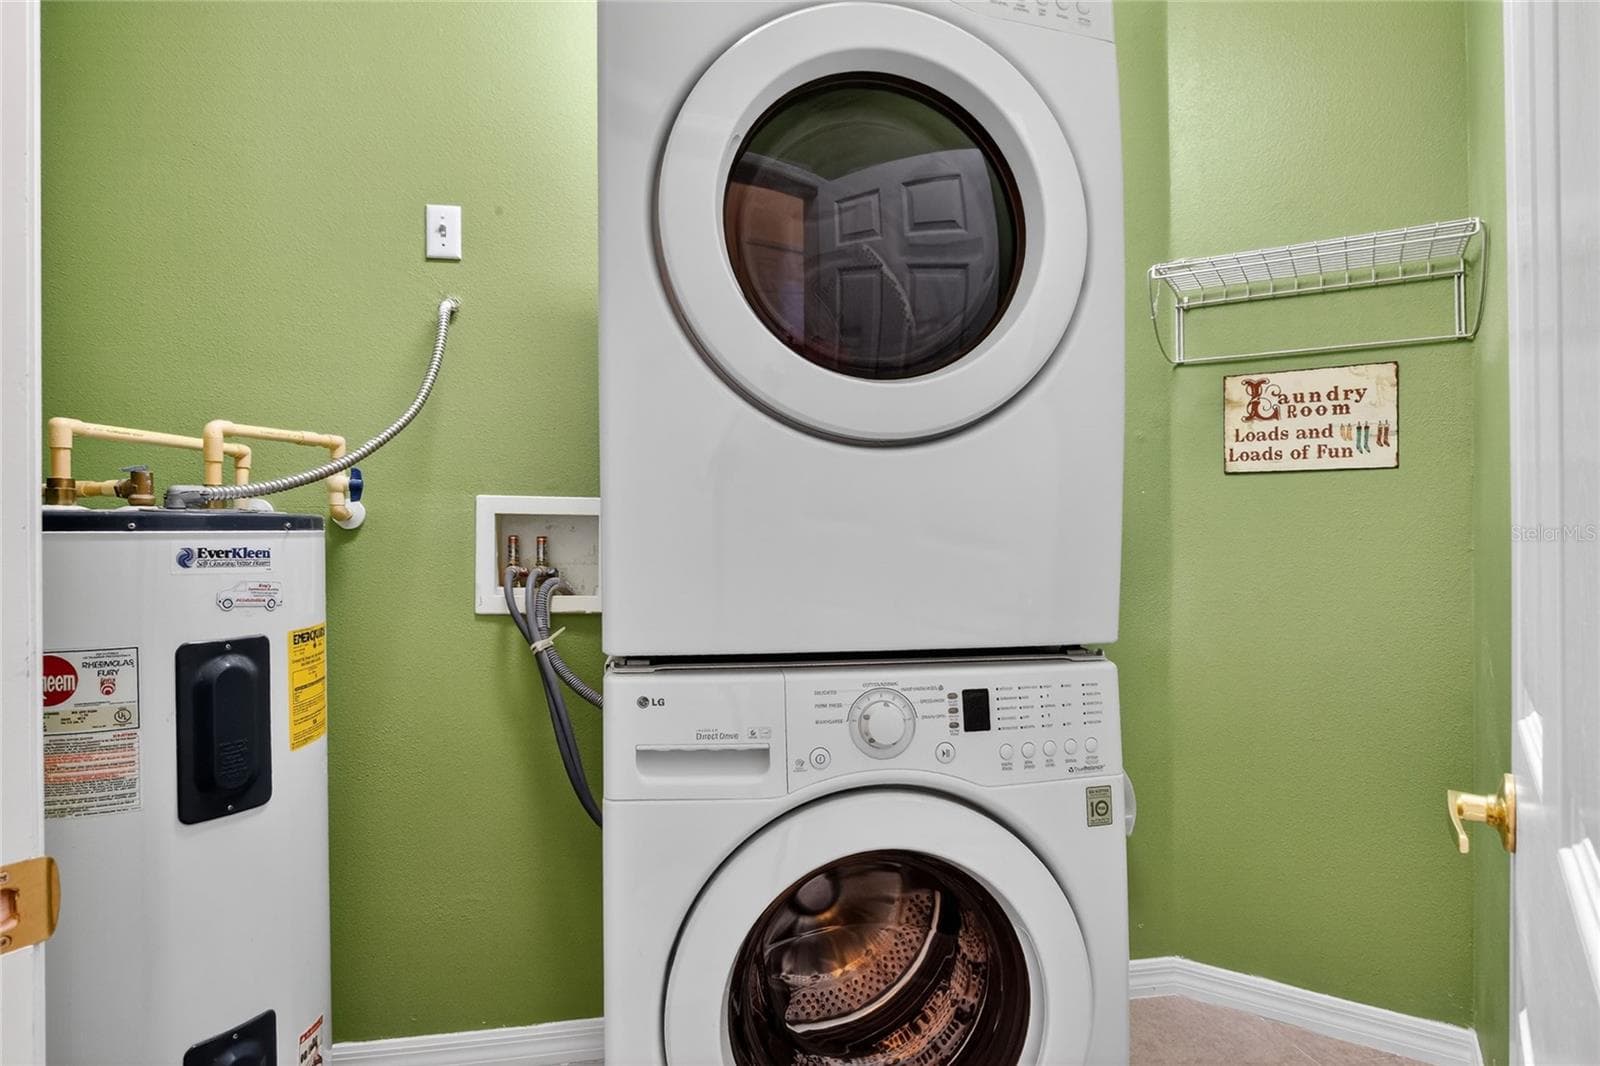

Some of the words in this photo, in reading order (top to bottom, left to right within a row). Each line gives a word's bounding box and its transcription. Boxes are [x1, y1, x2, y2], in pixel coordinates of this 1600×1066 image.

[1241, 378, 1367, 422] Laundry
[1234, 426, 1289, 443] Loads
[1296, 424, 1334, 439] and
[1228, 447, 1283, 462] Loads
[1290, 445, 1310, 460] of
[1317, 444, 1353, 459] Fun
[197, 547, 271, 559] EverKleen
[651, 698, 665, 706] LG
